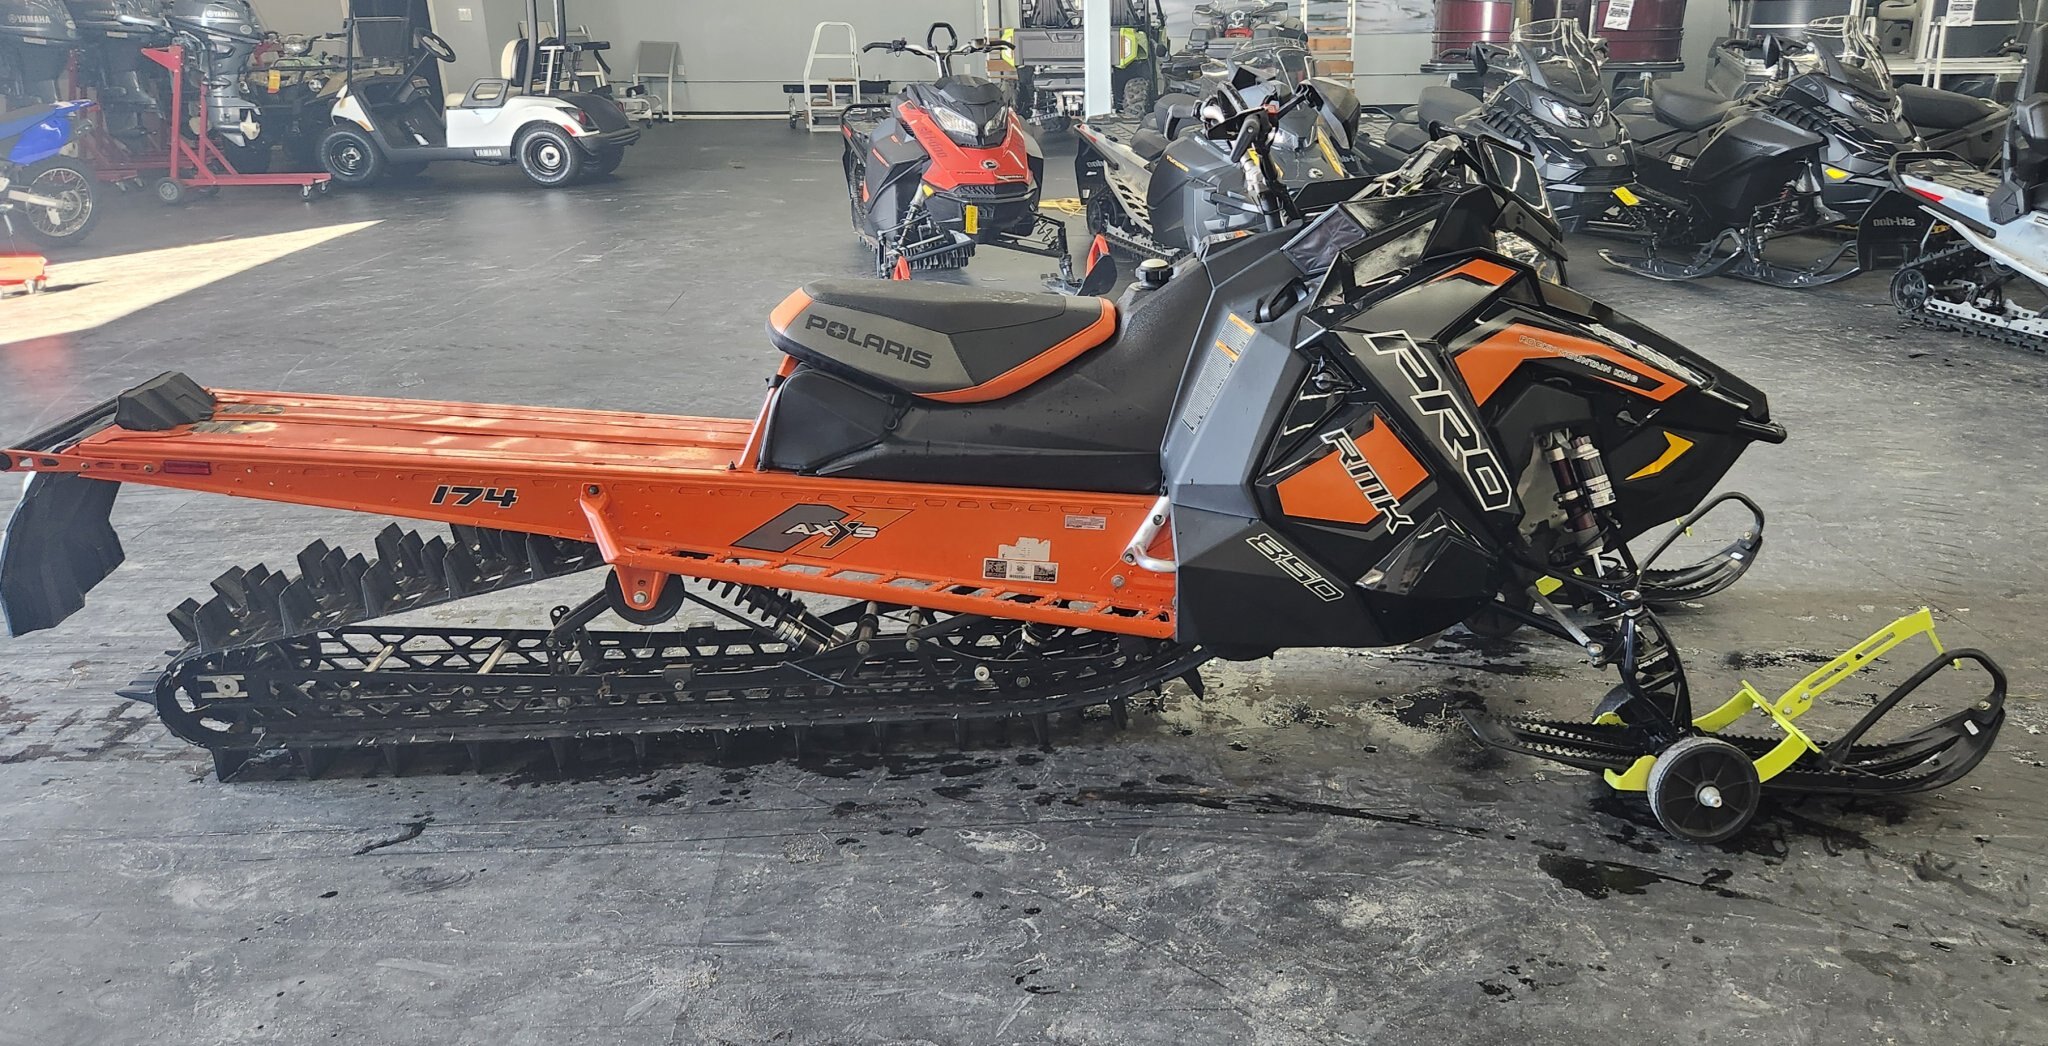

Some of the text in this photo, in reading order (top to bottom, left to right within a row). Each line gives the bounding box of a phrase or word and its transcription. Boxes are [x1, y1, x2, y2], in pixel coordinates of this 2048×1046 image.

[17, 15, 51, 24] YAMAHA
[215, 10, 239, 18] YAMAHA
[474, 149, 502, 157] YAMAHA
[805, 314, 933, 369] POLARIS
[1519, 335, 1639, 384] ROCKY MOUNTAIN KING
[1363, 329, 1512, 512] PRO
[430, 484, 519, 509] 174
[1320, 428, 1415, 535] RMK
[782, 519, 879, 549] AXYS
[1245, 532, 1345, 602] 850
